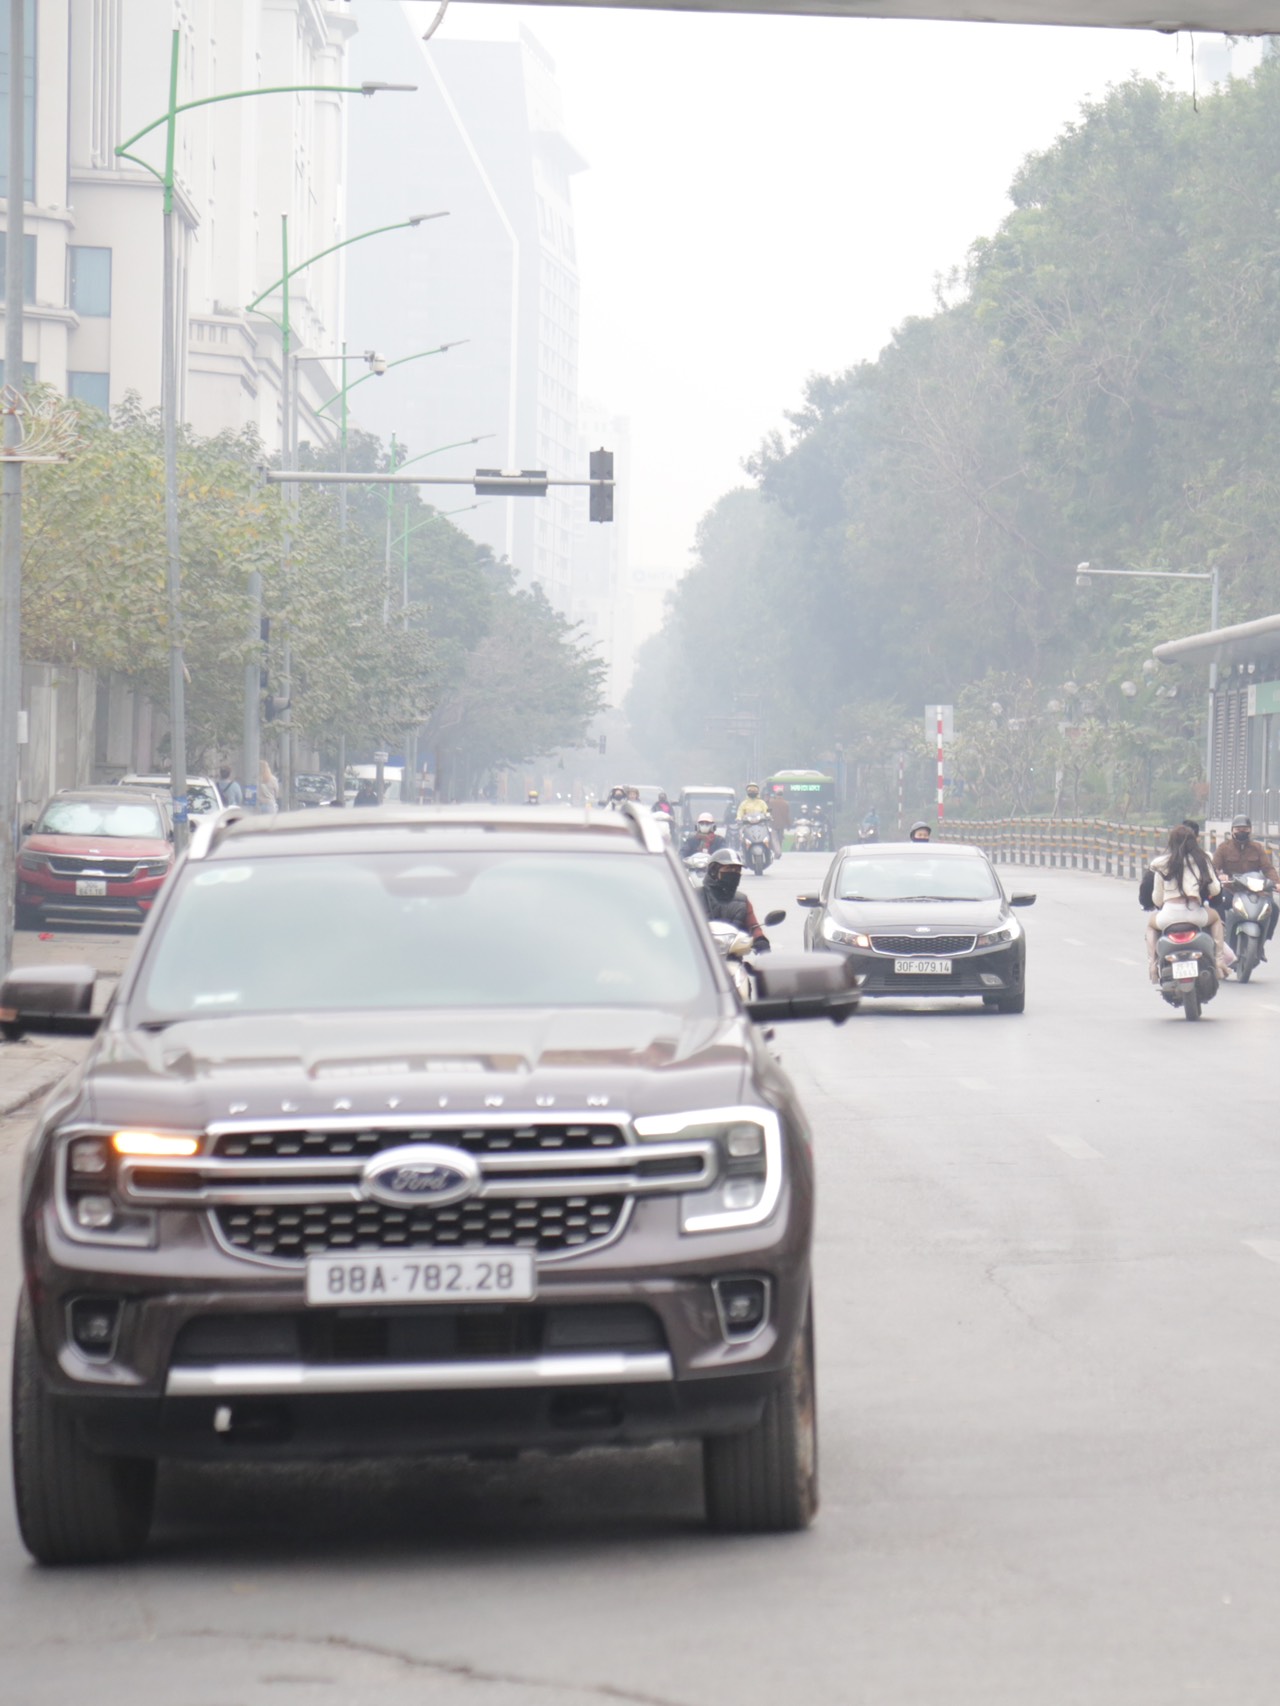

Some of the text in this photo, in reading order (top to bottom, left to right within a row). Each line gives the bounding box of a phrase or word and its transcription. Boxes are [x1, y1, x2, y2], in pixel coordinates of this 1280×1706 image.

[896, 961, 950, 972] 30F-079.14
[229, 1094, 609, 1114] PLATINUM
[392, 1167, 450, 1191] Ford
[327, 1263, 514, 1294] 88A-782.28
